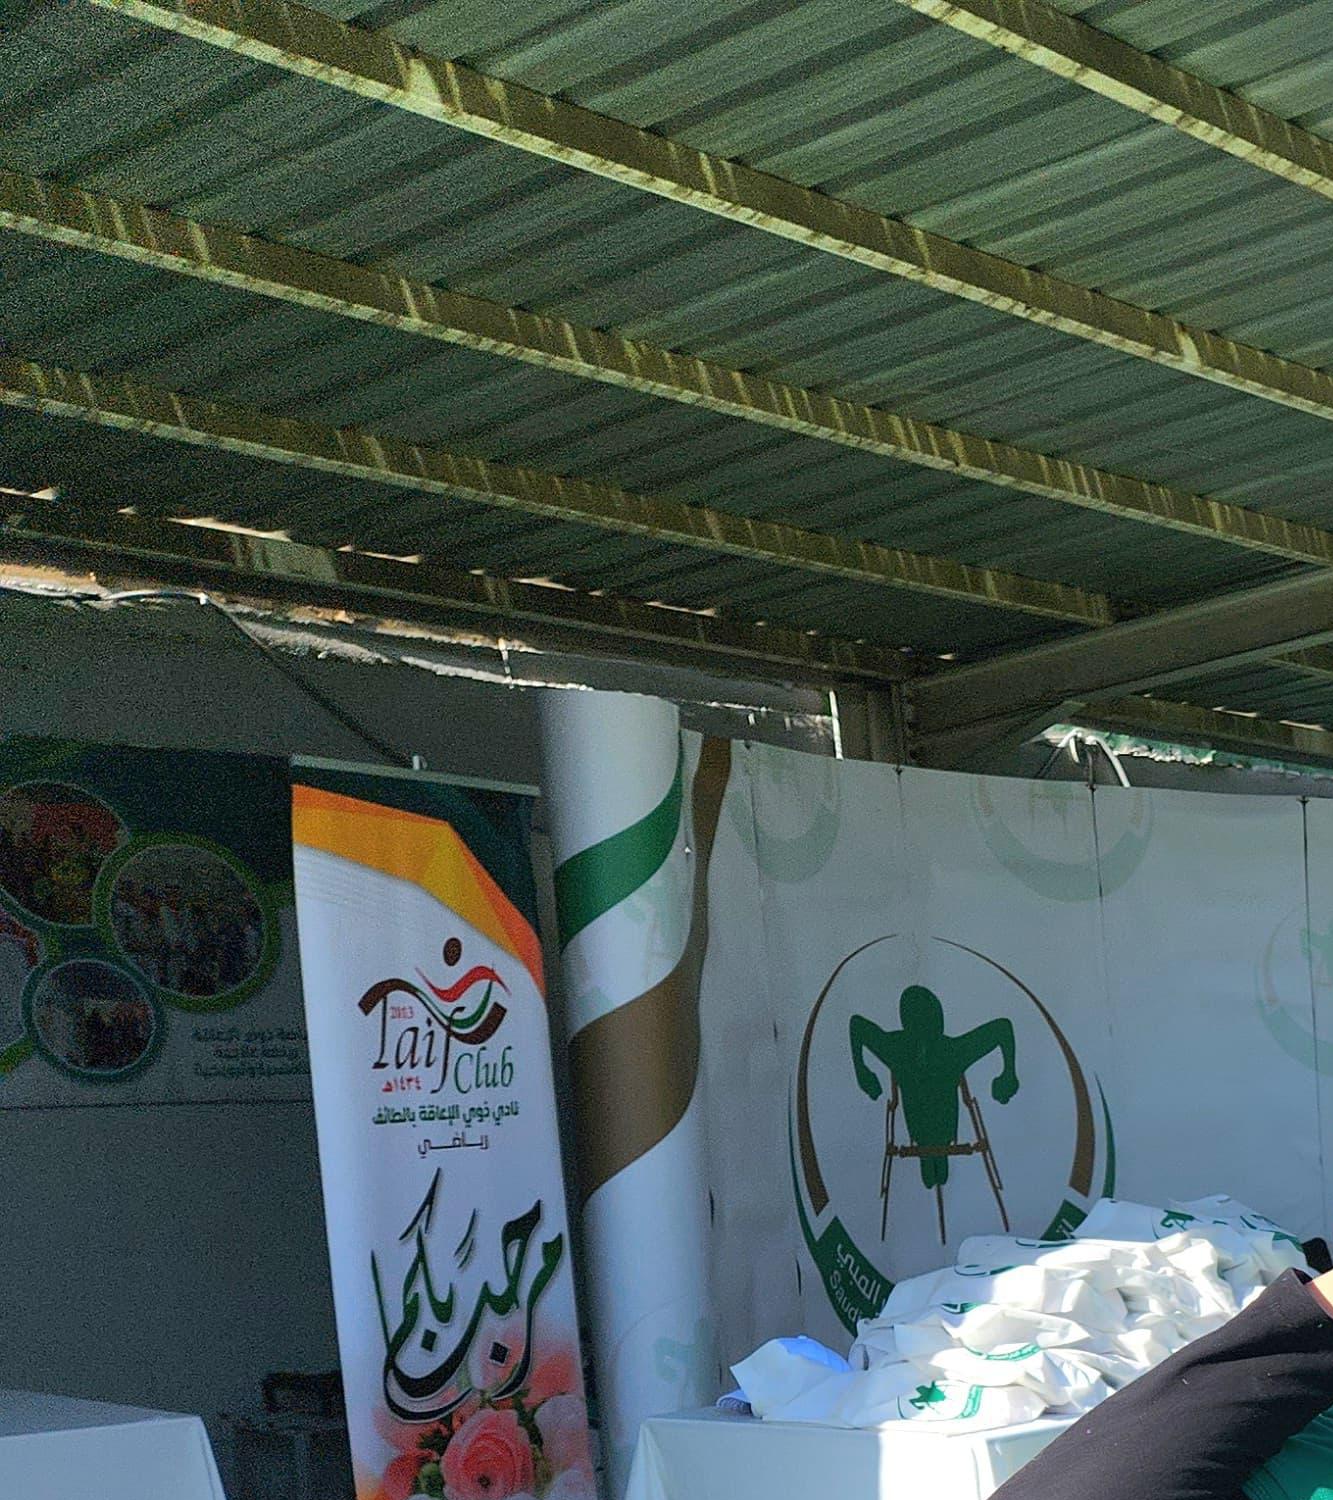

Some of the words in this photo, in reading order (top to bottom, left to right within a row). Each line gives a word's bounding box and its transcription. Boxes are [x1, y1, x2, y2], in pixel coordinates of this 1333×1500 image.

[369, 990, 467, 1095] Taif
[453, 1045, 515, 1095] Club
[372, 1105, 416, 1127] بالطائف
[418, 1104, 460, 1127] الإعاقة
[462, 1102, 490, 1128] ذوي
[492, 1101, 520, 1126] نادي
[829, 1270, 862, 1323] Saud
